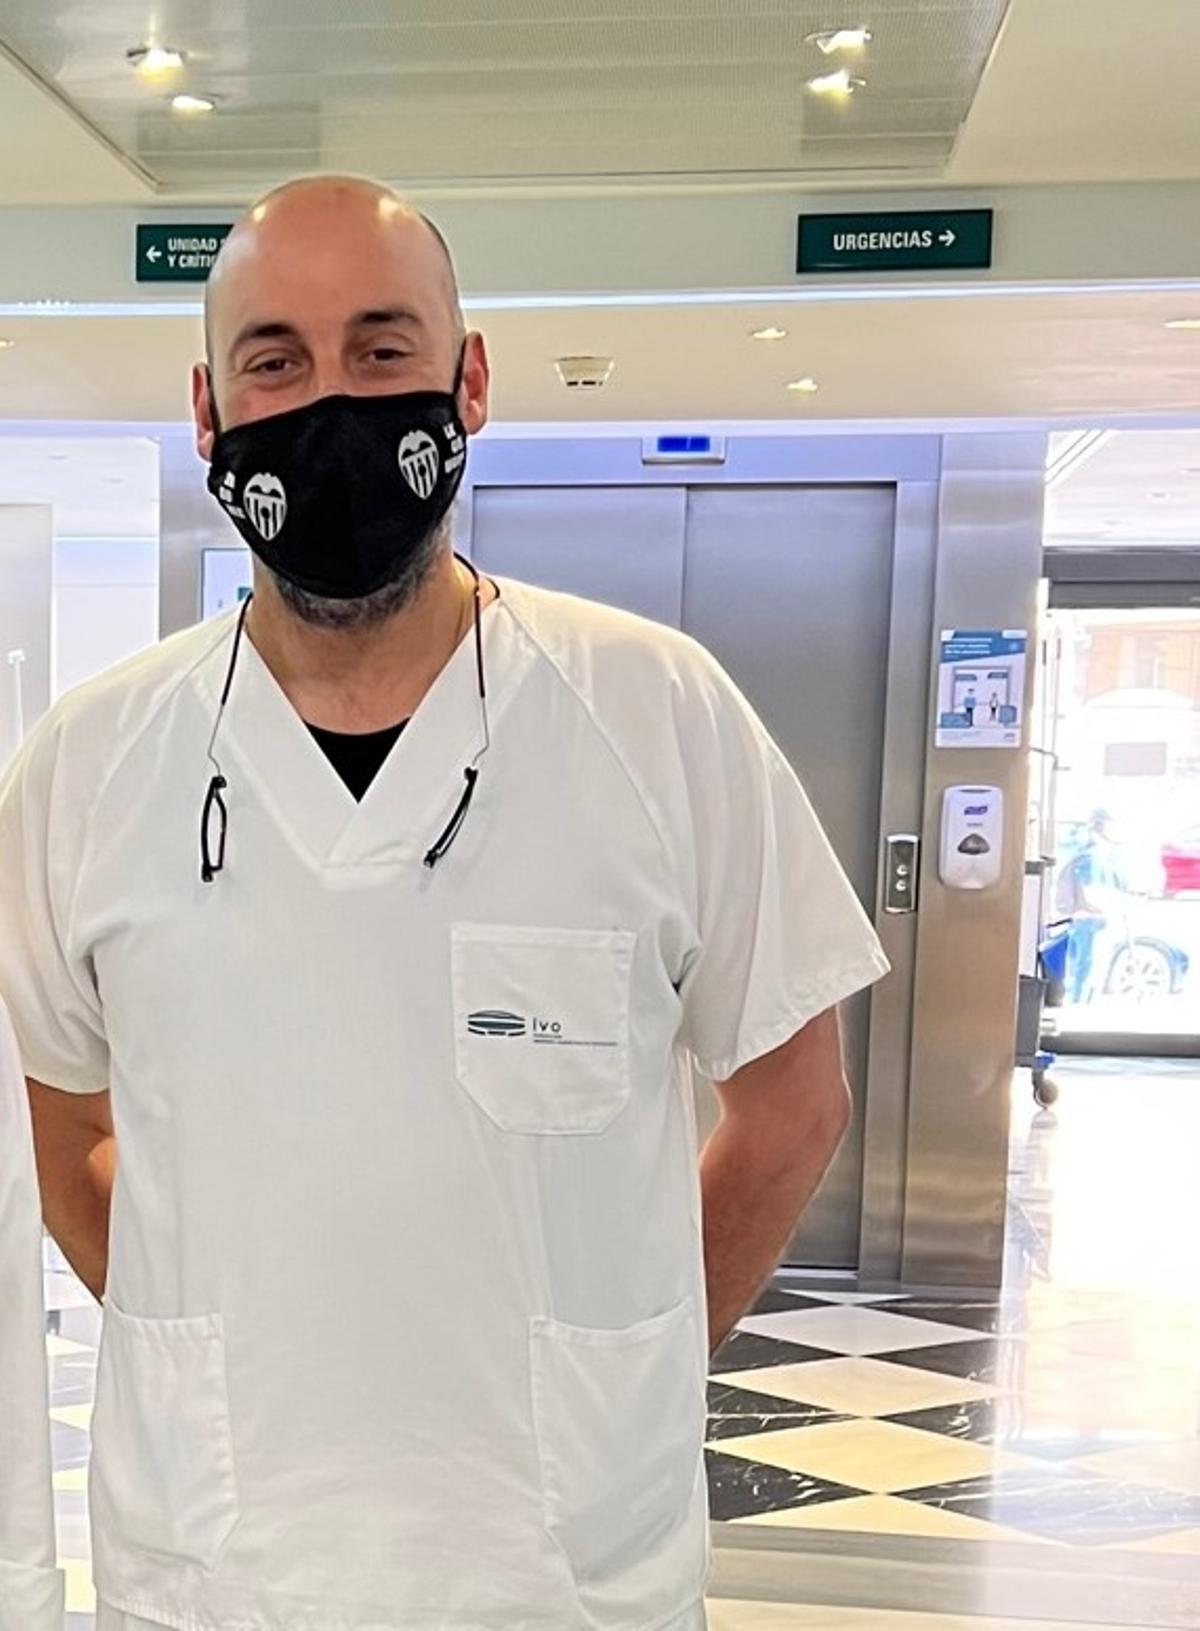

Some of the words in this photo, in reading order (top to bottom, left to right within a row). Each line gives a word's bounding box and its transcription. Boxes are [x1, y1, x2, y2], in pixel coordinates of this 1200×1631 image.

[167, 237, 218, 252] UNIDAD
[832, 229, 933, 251] URGENCIAS
[167, 254, 177, 268] Y
